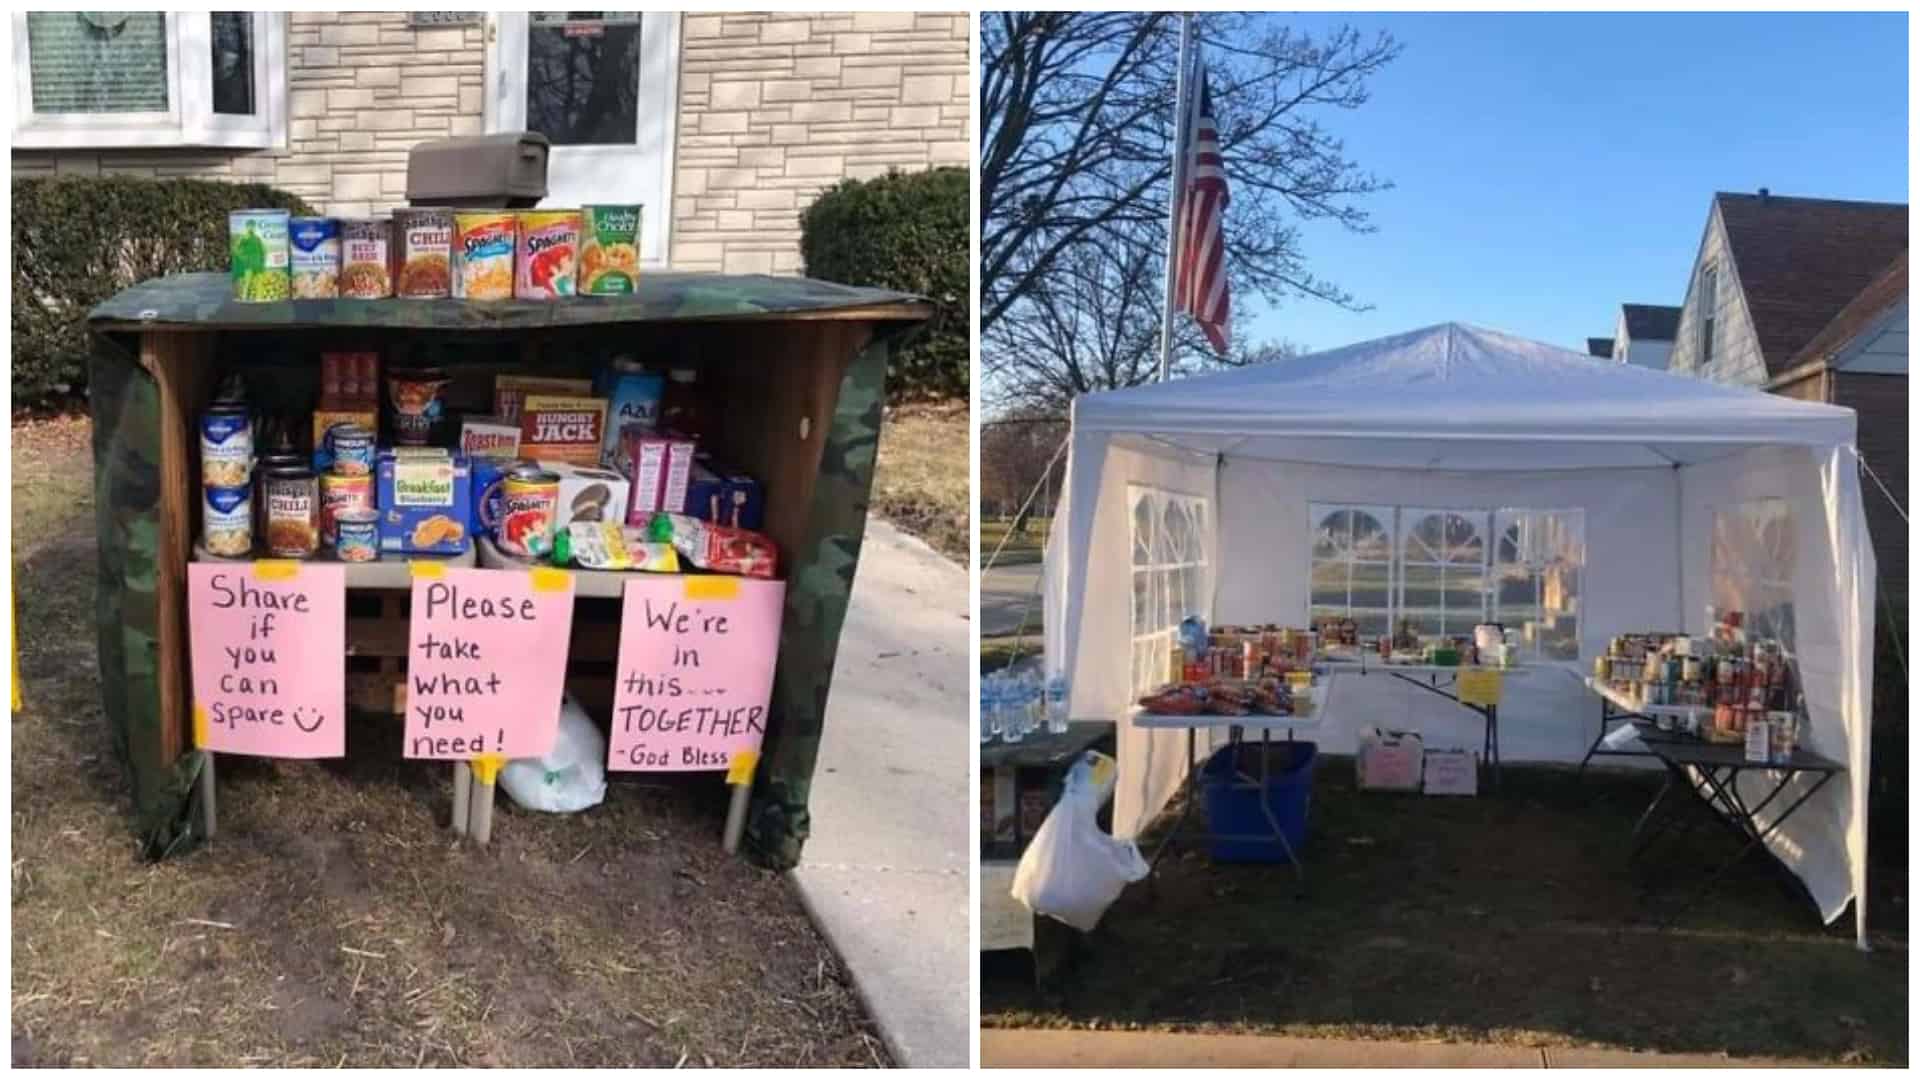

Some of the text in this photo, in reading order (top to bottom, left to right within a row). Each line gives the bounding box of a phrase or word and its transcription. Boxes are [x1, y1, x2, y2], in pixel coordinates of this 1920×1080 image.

[536, 412, 596, 425] HUNGRY
[531, 424, 596, 442] JACK
[396, 480, 451, 494] Breakfast
[211, 574, 310, 613] Share
[425, 582, 537, 621] Please
[249, 612, 275, 641] if
[644, 600, 729, 635] We're
[225, 646, 277, 669] you
[417, 633, 482, 660] take
[673, 645, 701, 668] in
[415, 672, 502, 695] what
[416, 704, 465, 729] you
[618, 704, 766, 737] TOGETHER
[682, 746, 729, 766] Bless
